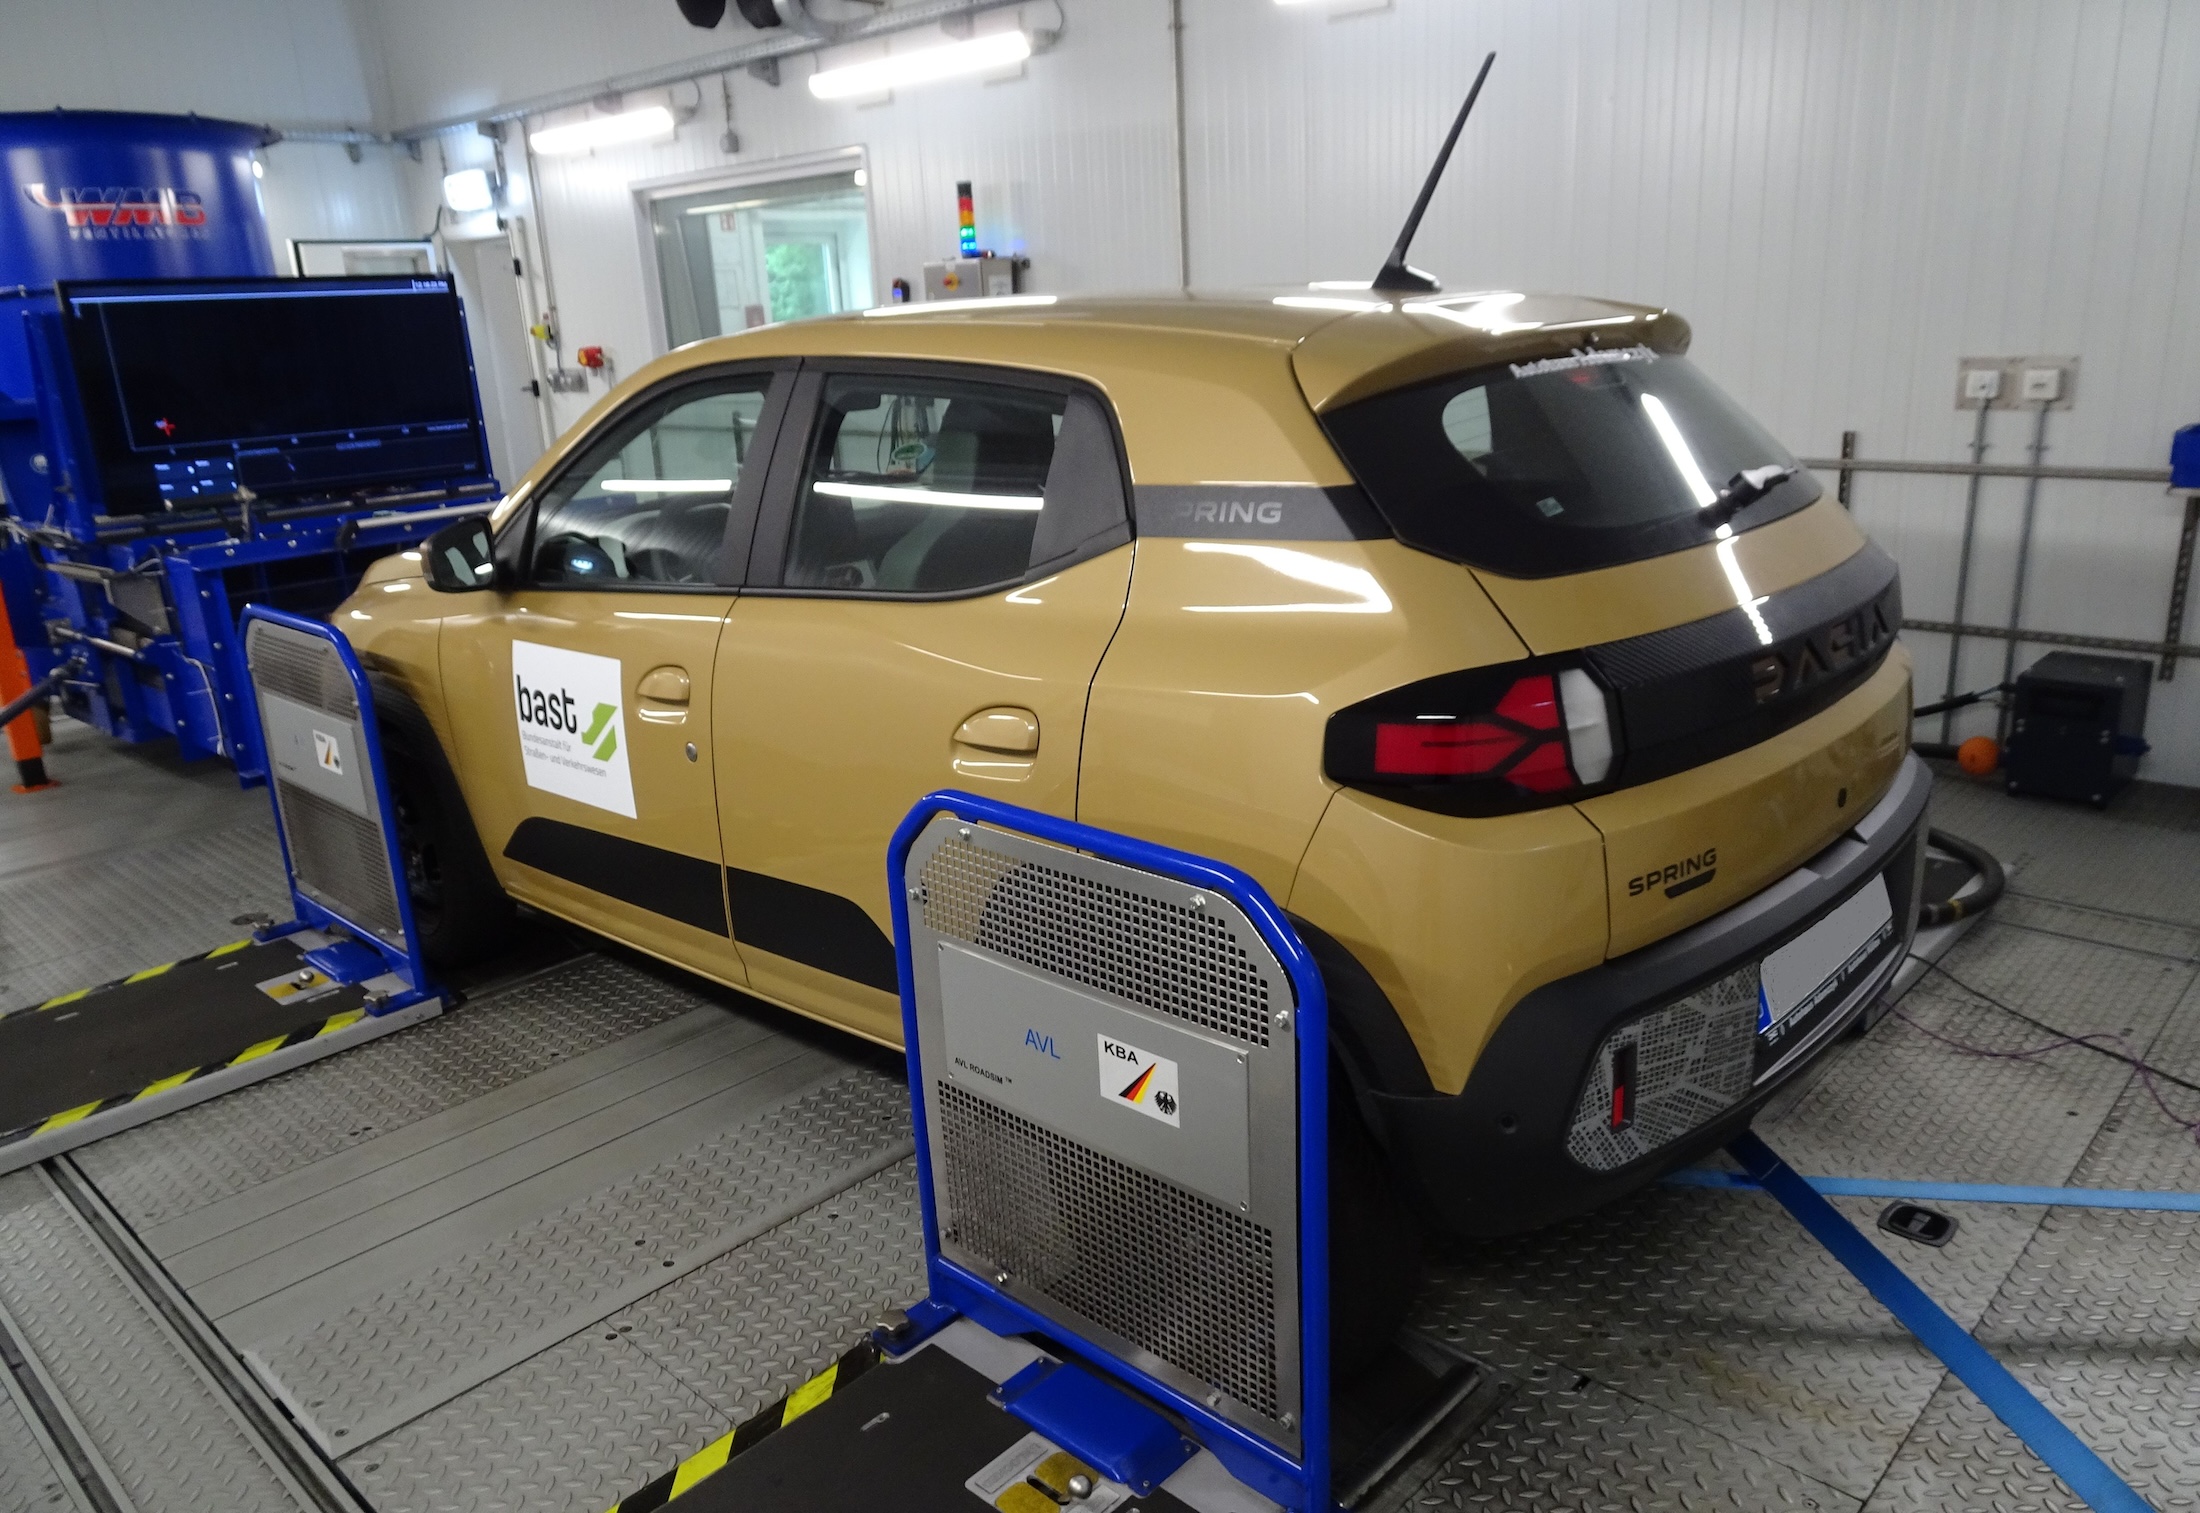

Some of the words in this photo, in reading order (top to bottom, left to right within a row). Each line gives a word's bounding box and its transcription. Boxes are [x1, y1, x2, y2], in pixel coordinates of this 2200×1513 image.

[1168, 501, 1284, 524] PRING
[516, 674, 578, 734] bast
[1628, 847, 1717, 897] SPRING
[1025, 1028, 1061, 1060] AVL
[1104, 1040, 1139, 1065] KBA
[954, 1057, 968, 1070] AVL
[969, 1063, 1003, 1084] ROADSIM
